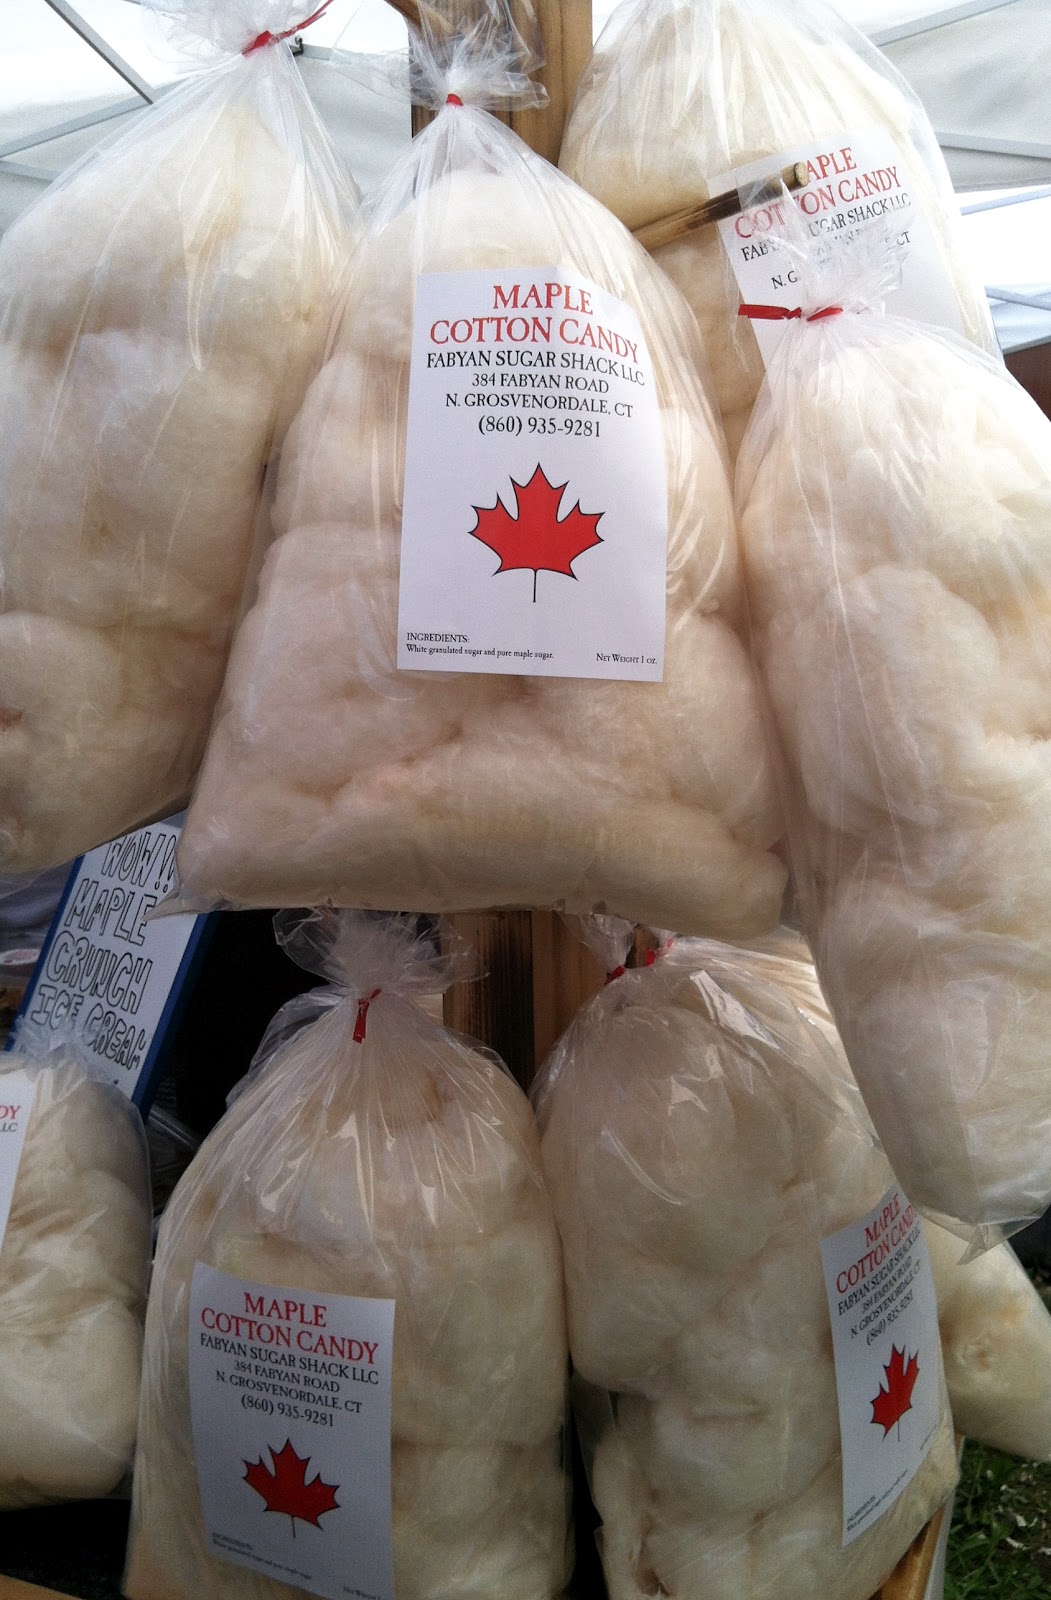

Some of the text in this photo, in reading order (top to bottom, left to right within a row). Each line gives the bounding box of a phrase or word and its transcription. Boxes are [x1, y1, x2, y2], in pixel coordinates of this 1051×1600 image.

[806, 147, 857, 182] APLE
[734, 166, 901, 238] COTON CANDY
[808, 213, 847, 238] UGAR
[848, 198, 889, 225] SHACK
[493, 282, 593, 315] MAPLE
[430, 316, 638, 364] COTTON CANDY
[426, 350, 645, 387] FABYAN SUGAR SHACK LLC
[472, 373, 609, 394] 384 FABYAN ROAD
[445, 393, 633, 418] N. GROSVENORDALE, CT
[478, 415, 601, 438] (860) 935-9281
[406, 632, 470, 644] INGREDIENTS:
[406, 644, 554, 660] White granulated sugar and pure maple sugar.
[64, 878, 158, 946] MAPLE
[46, 930, 153, 1015] CRUNCH
[30, 984, 84, 1031] ICE
[864, 1192, 900, 1248] MAPLE
[836, 1234, 890, 1294] COTTON
[244, 1292, 327, 1327] MAPLE
[838, 1281, 870, 1316] FABYAN
[201, 1307, 379, 1365] COTTON CANDY
[200, 1332, 379, 1385] FABYAN SUGAR SHACK LLC
[234, 1359, 340, 1393] 384 FABYAN ROAD
[216, 1370, 362, 1414] N. GROSVENORDALE, CT
[241, 1394, 335, 1427] (860) 935-9281
